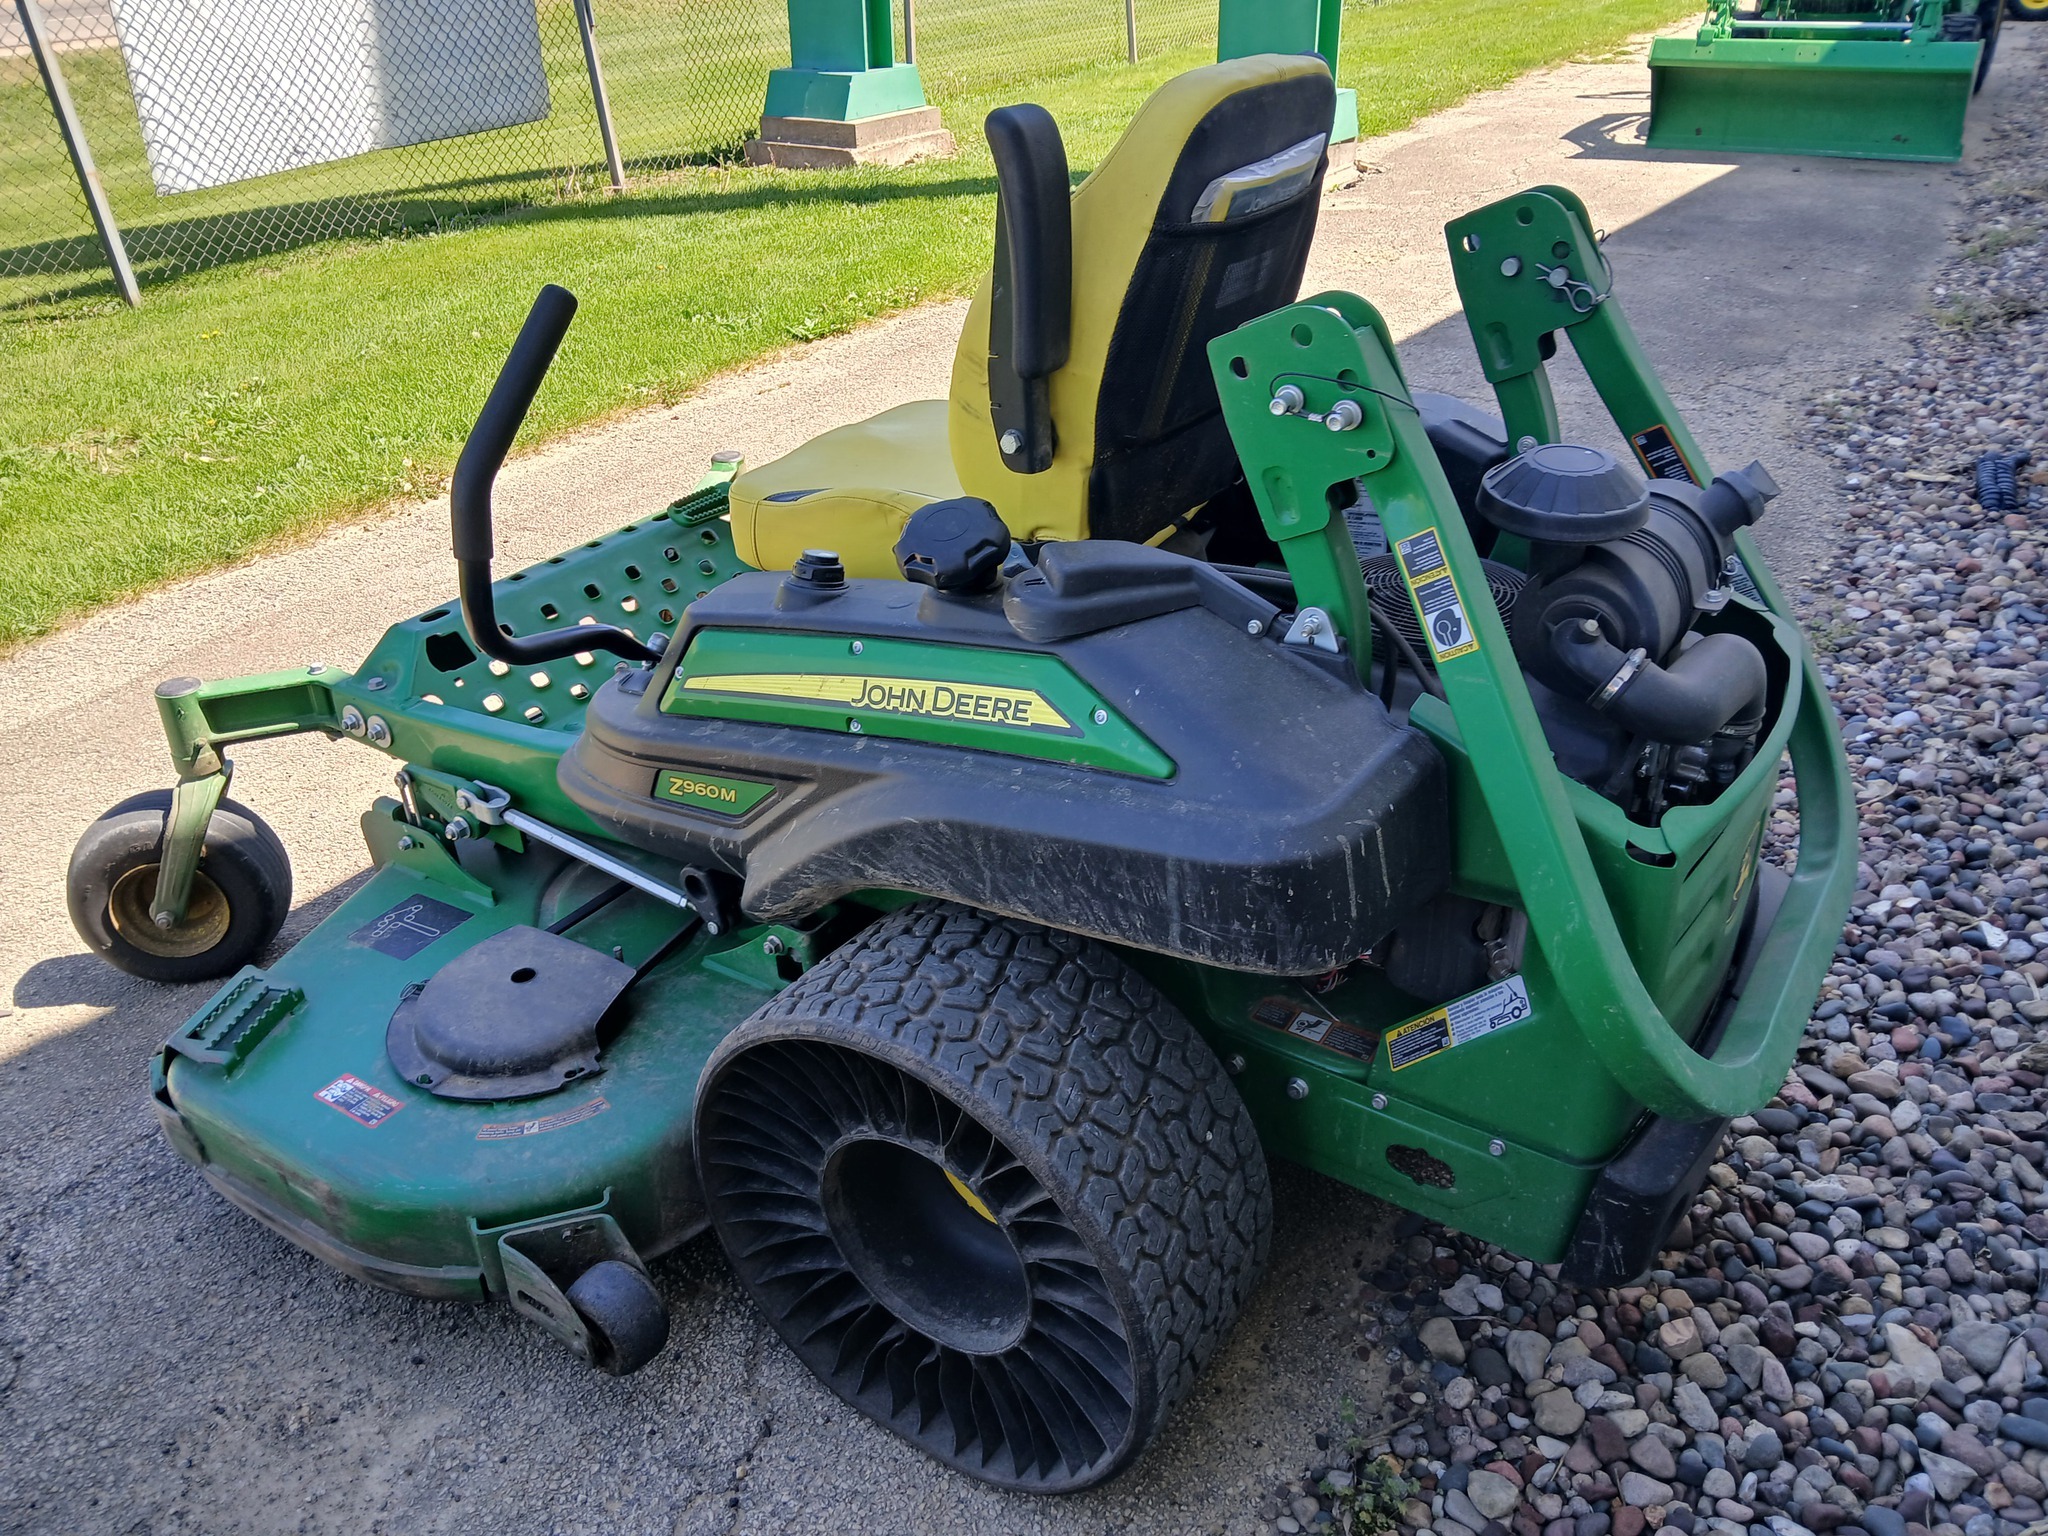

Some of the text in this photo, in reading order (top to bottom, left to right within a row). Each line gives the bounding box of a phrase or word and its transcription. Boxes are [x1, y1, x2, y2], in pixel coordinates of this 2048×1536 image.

[1440, 644, 1469, 659] CAUTION
[851, 679, 1033, 723] JOHN DEERE
[669, 777, 736, 803] Z960M
[1403, 1015, 1435, 1034] ATENCIÓN
